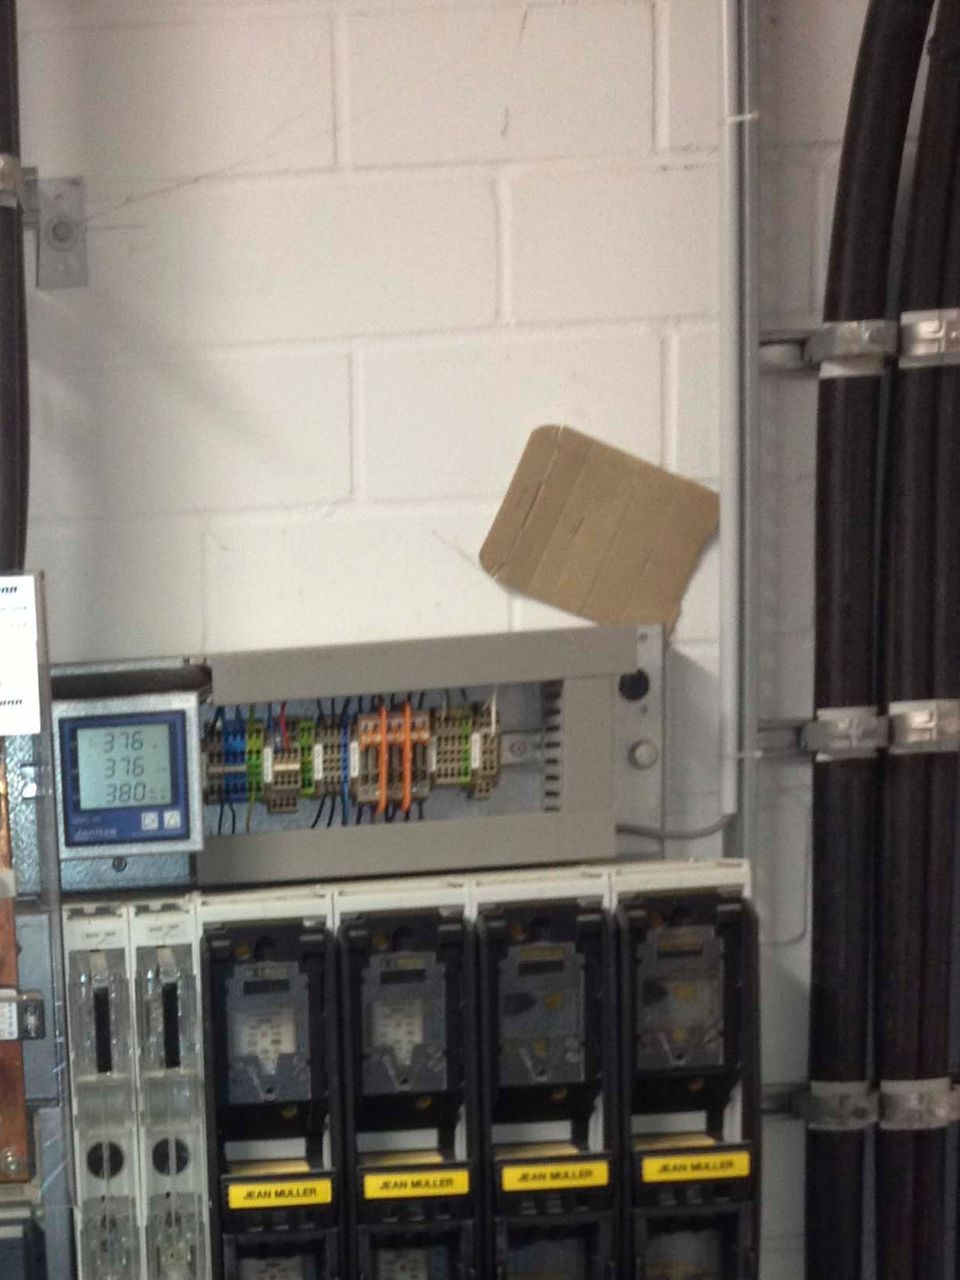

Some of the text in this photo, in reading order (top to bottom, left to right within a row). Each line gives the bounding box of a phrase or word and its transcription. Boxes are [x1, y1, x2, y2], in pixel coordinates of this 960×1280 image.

[104, 731, 144, 752] 376
[105, 756, 145, 778] 376
[106, 782, 146, 804] 380
[659, 1164, 688, 1174] JEAN
[518, 1173, 547, 1183] JEAN
[380, 1181, 408, 1191] JEAN
[243, 1190, 272, 1200] JEAN
